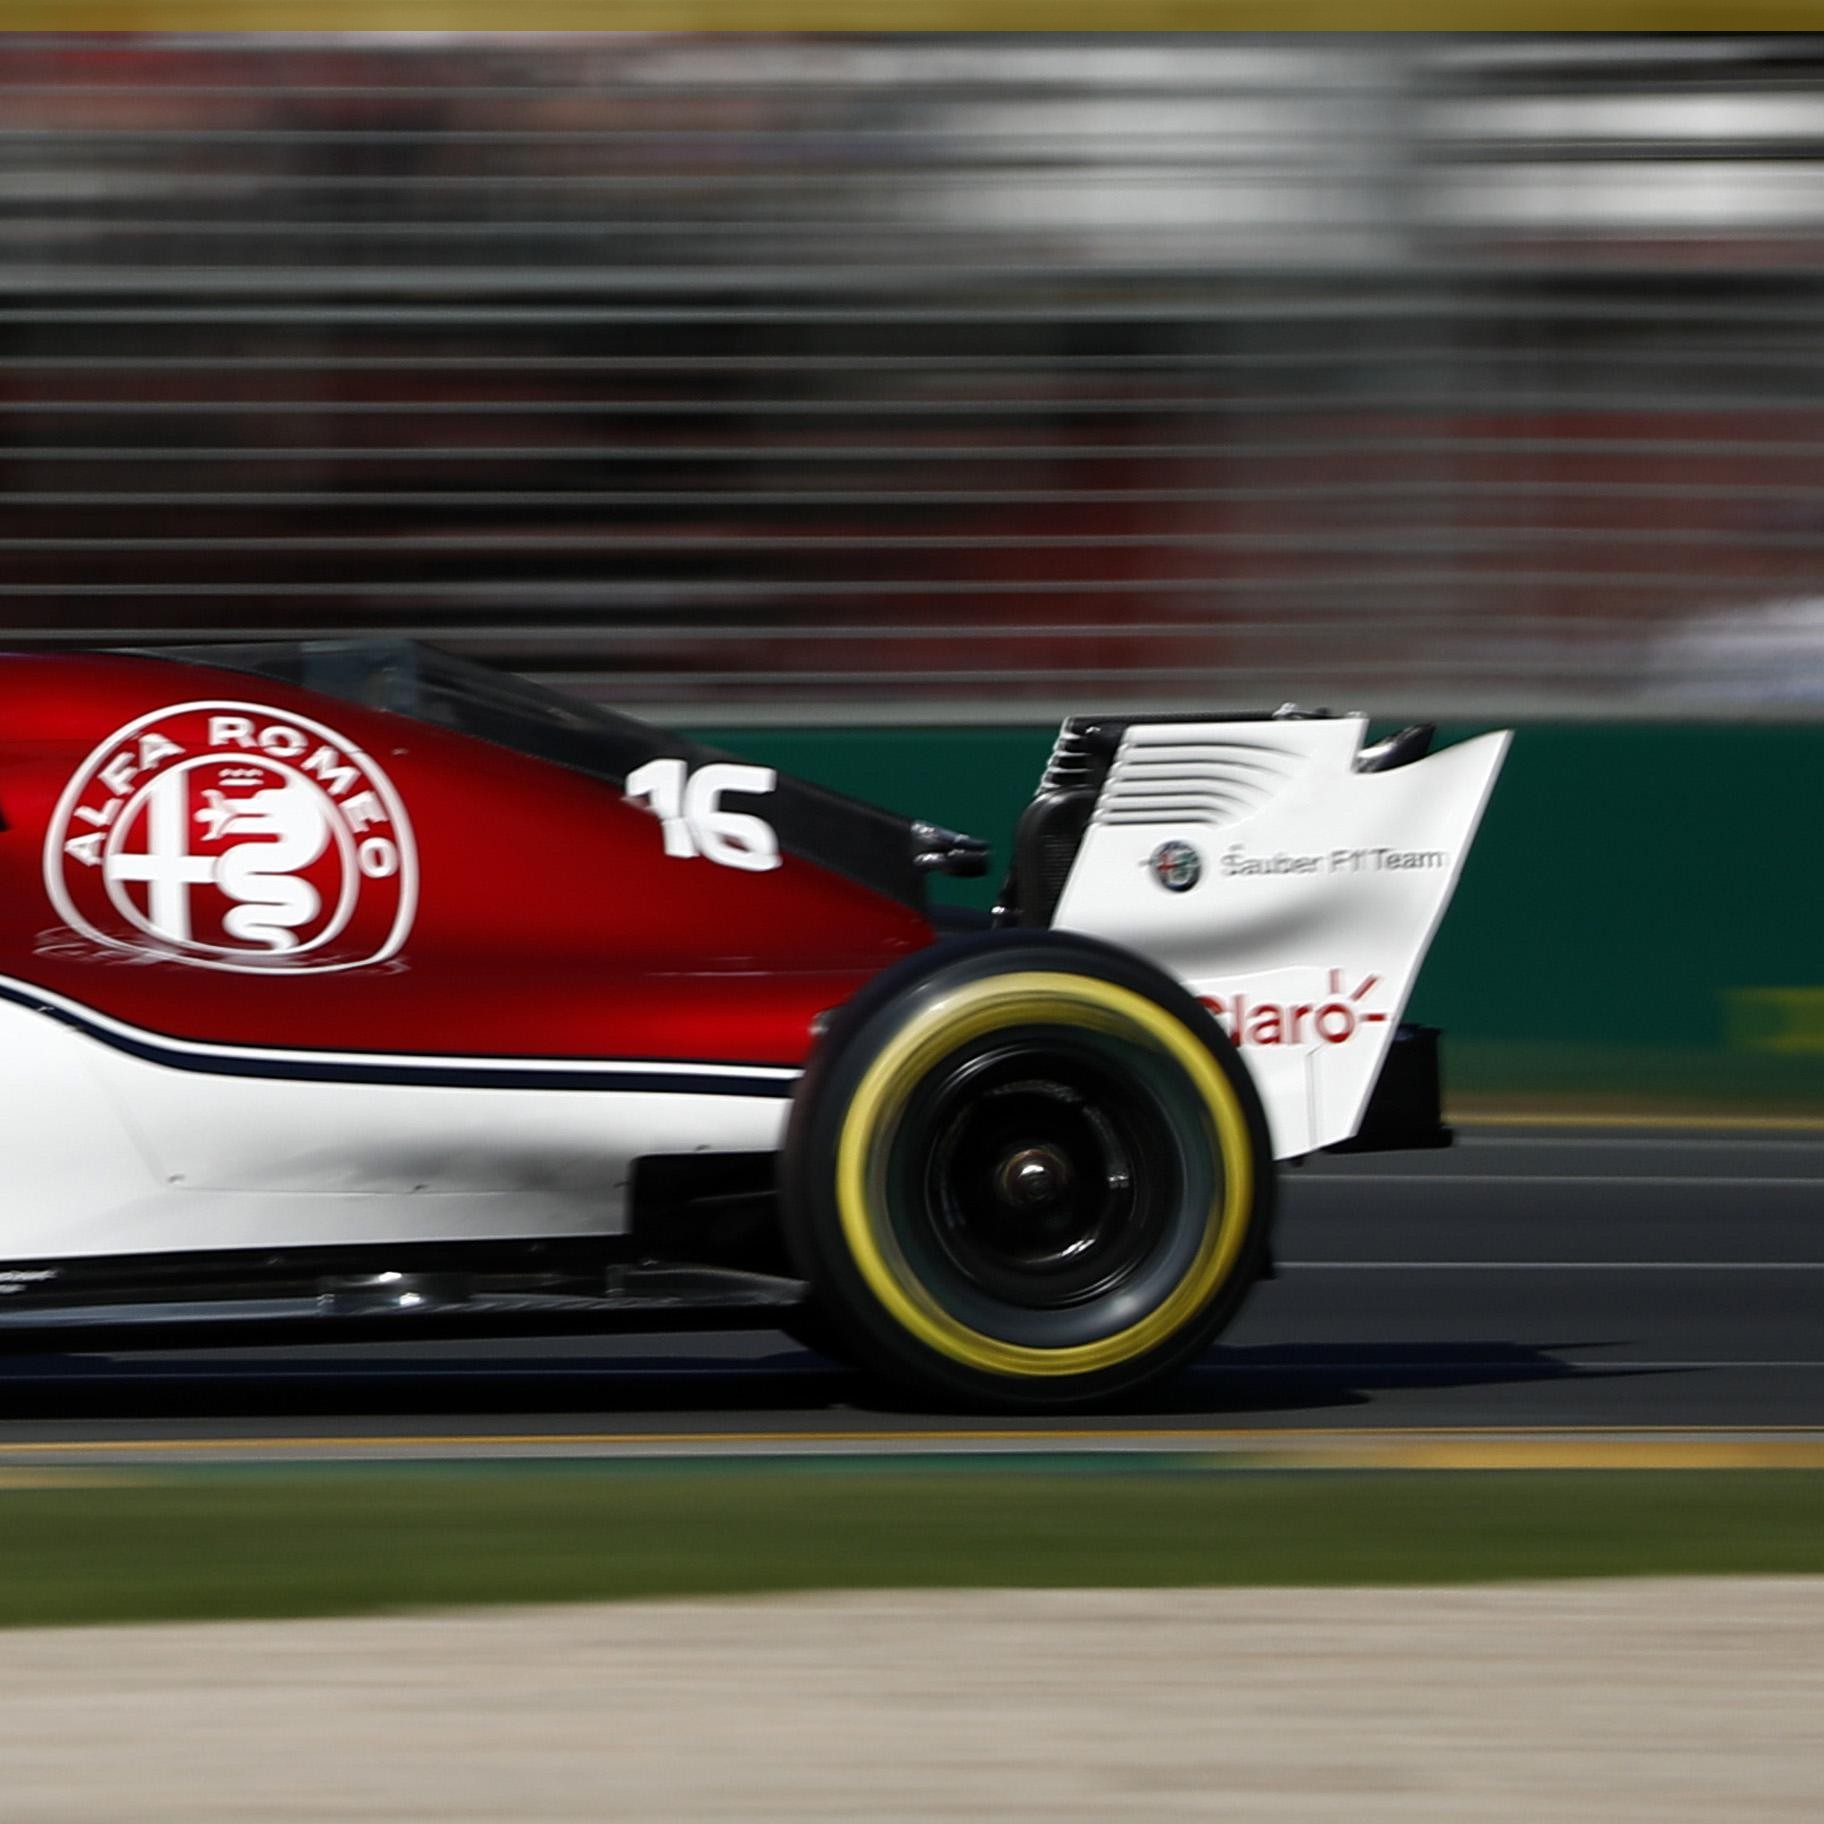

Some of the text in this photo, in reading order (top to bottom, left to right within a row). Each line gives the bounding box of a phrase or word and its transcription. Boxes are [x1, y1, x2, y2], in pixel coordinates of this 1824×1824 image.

[65, 716, 399, 878] ALFA ROMEO
[624, 759, 783, 872] 16
[1220, 851, 1323, 876] Sauber
[1366, 848, 1445, 874] Team
